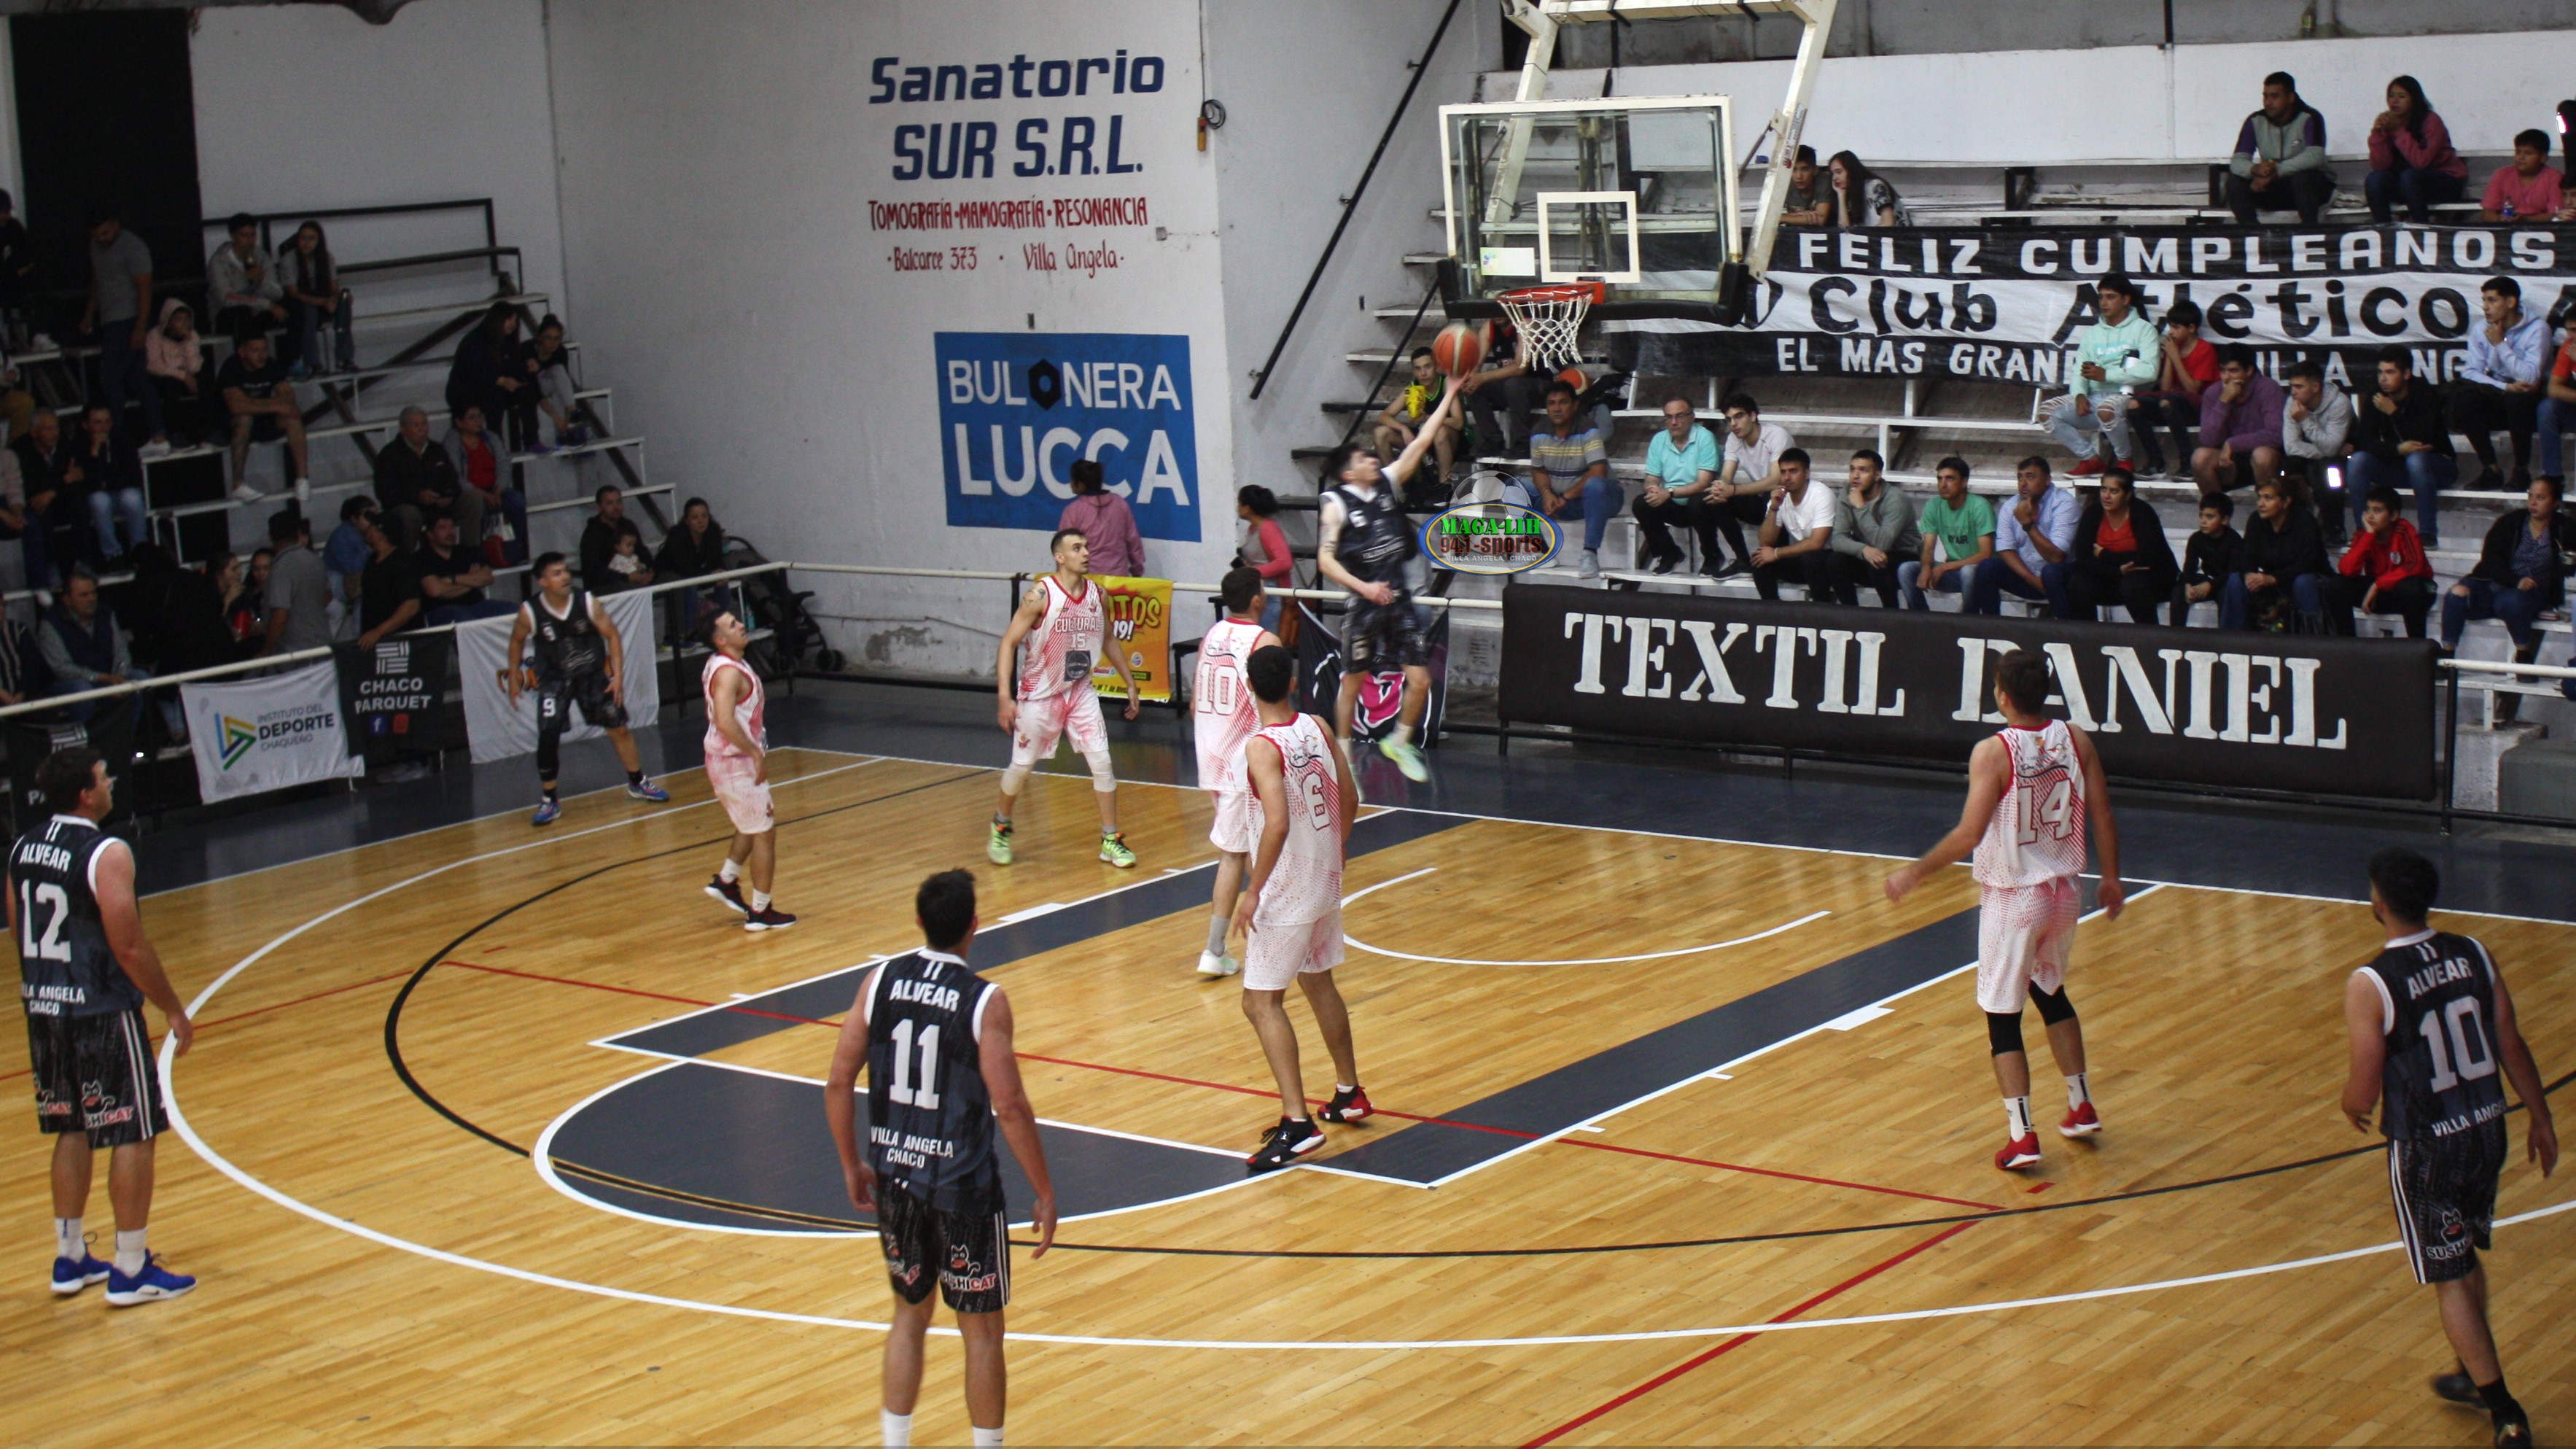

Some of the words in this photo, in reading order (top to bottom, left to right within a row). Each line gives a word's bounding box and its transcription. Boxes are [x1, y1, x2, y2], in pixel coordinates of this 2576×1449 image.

[869, 50, 1164, 104] Sanatorio
[892, 121, 997, 180] SUR
[1013, 114, 1143, 178] S.R.L.
[950, 246, 978, 271] 373
[1023, 243, 1057, 271] Villa
[1799, 233, 1982, 274] FELIZ
[1808, 276, 1998, 336] Club
[2051, 278, 2470, 348] Atético
[1777, 338, 1818, 373] EL
[1841, 338, 1926, 375] MAS
[1949, 343, 2078, 385] GRAN
[954, 423, 1191, 506] LUCCA
[1071, 632, 1086, 648] 15
[359, 677, 424, 694] CHACO
[1196, 662, 1239, 715] 10
[1565, 611, 1905, 717] TEXTIL
[1951, 636, 2347, 750] DANIEL
[257, 706, 305, 723] INSTITUTO
[306, 703, 324, 715] DEL
[354, 695, 432, 714] PARQUET
[542, 698, 556, 717] 9
[259, 712, 335, 740] DEPORTE
[2017, 777, 2075, 846] 14
[19, 843, 72, 873] ALVEAR
[21, 879, 72, 963] 12
[39, 985, 86, 1004] ANGELA
[889, 979, 961, 1012] ALVEAR
[2407, 957, 2474, 1001] ALVEAR
[28, 1001, 61, 1017] CHACO
[2419, 995, 2497, 1094] 10
[889, 1018, 941, 1110] 11
[871, 1125, 900, 1147] VILLA
[903, 1134, 954, 1159] ANGELA
[2431, 1114, 2472, 1137] VILLA
[886, 1147, 926, 1169] CHACO
